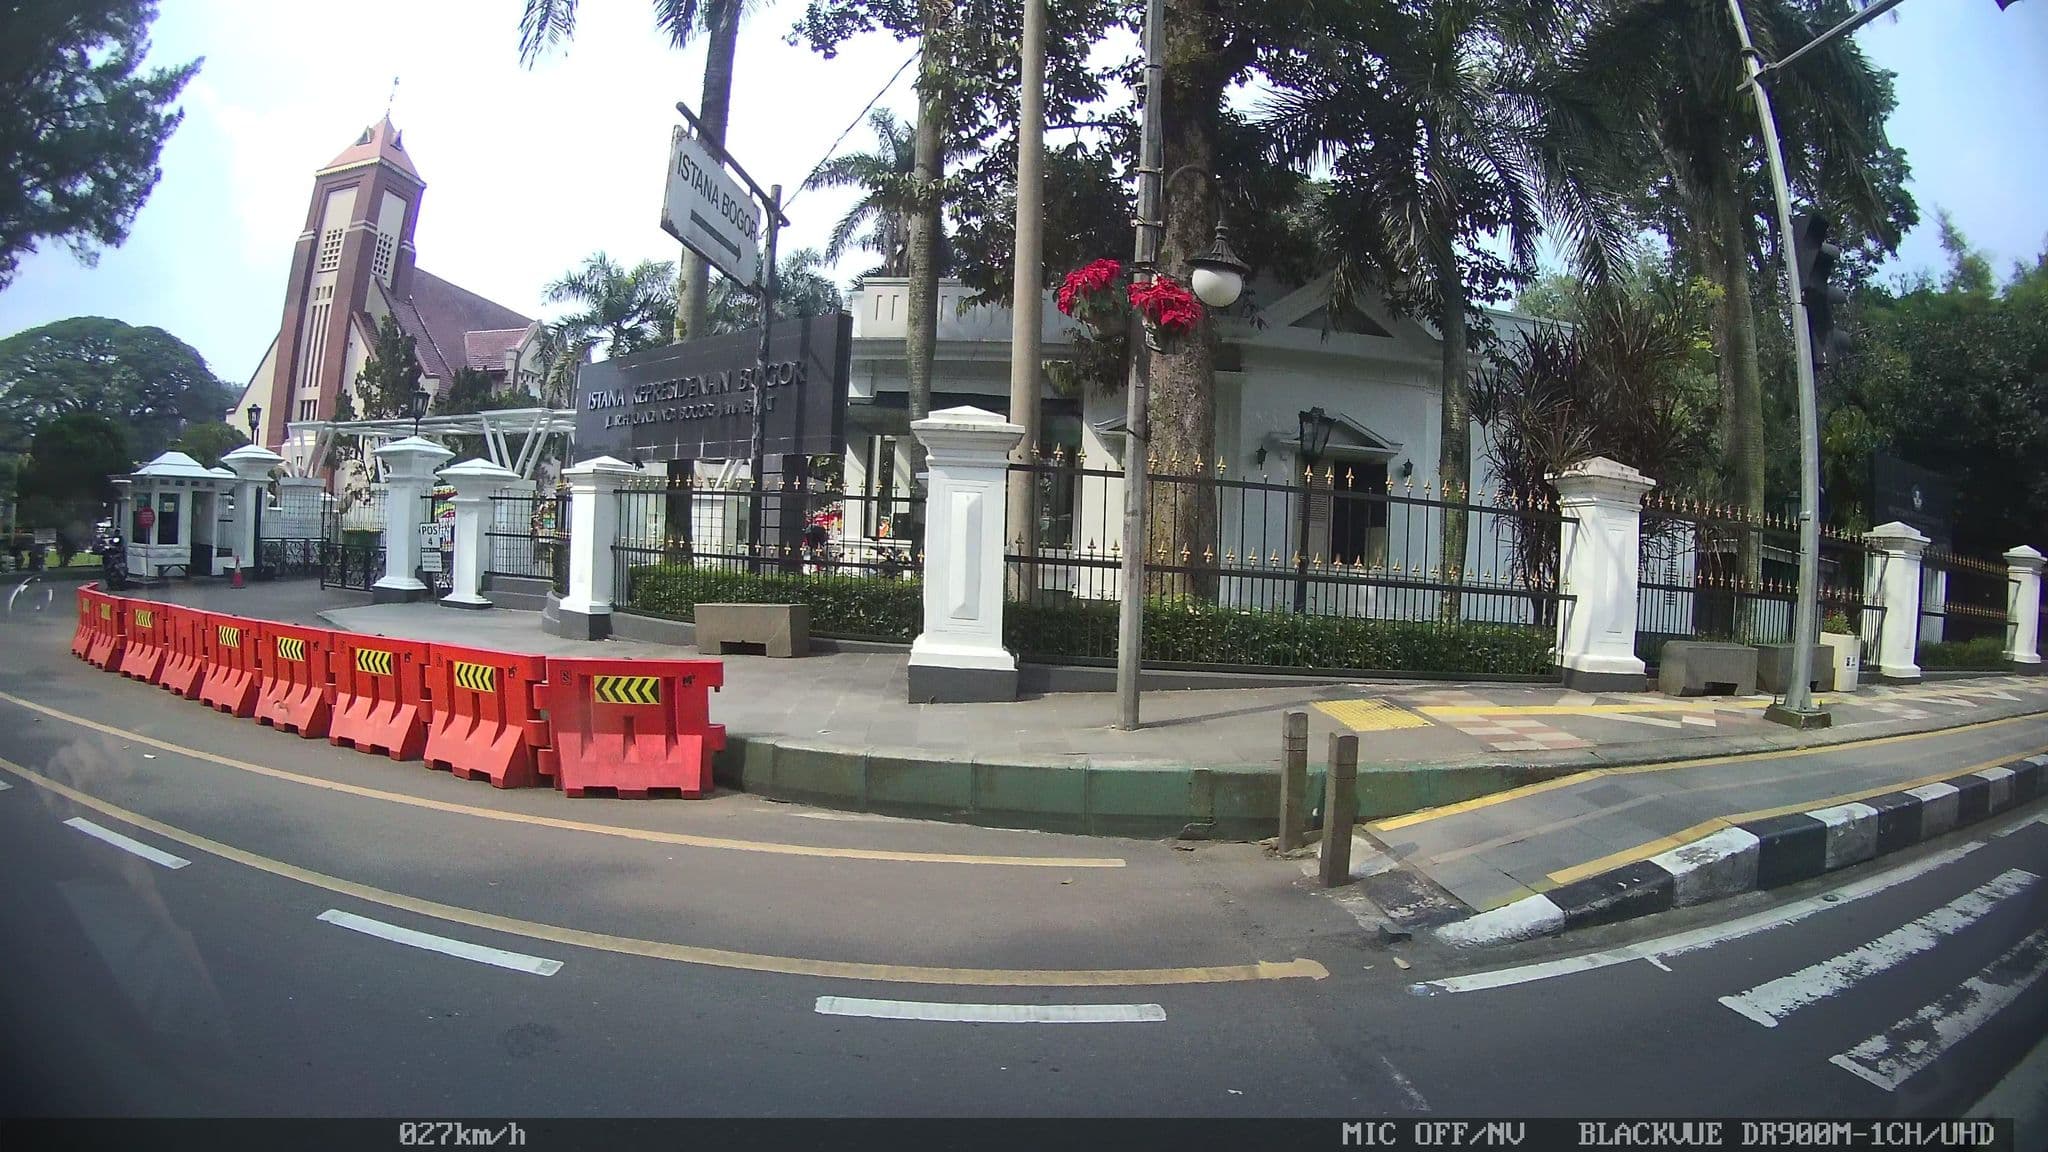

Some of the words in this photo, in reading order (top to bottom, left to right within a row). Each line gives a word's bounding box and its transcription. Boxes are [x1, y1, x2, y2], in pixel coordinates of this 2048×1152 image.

[677, 152, 720, 210] ISTANA
[721, 194, 758, 244] BOGOR
[587, 388, 625, 410] ISTANA
[737, 360, 808, 391] BGOR
[421, 525, 438, 536] POS
[427, 537, 434, 546] 4
